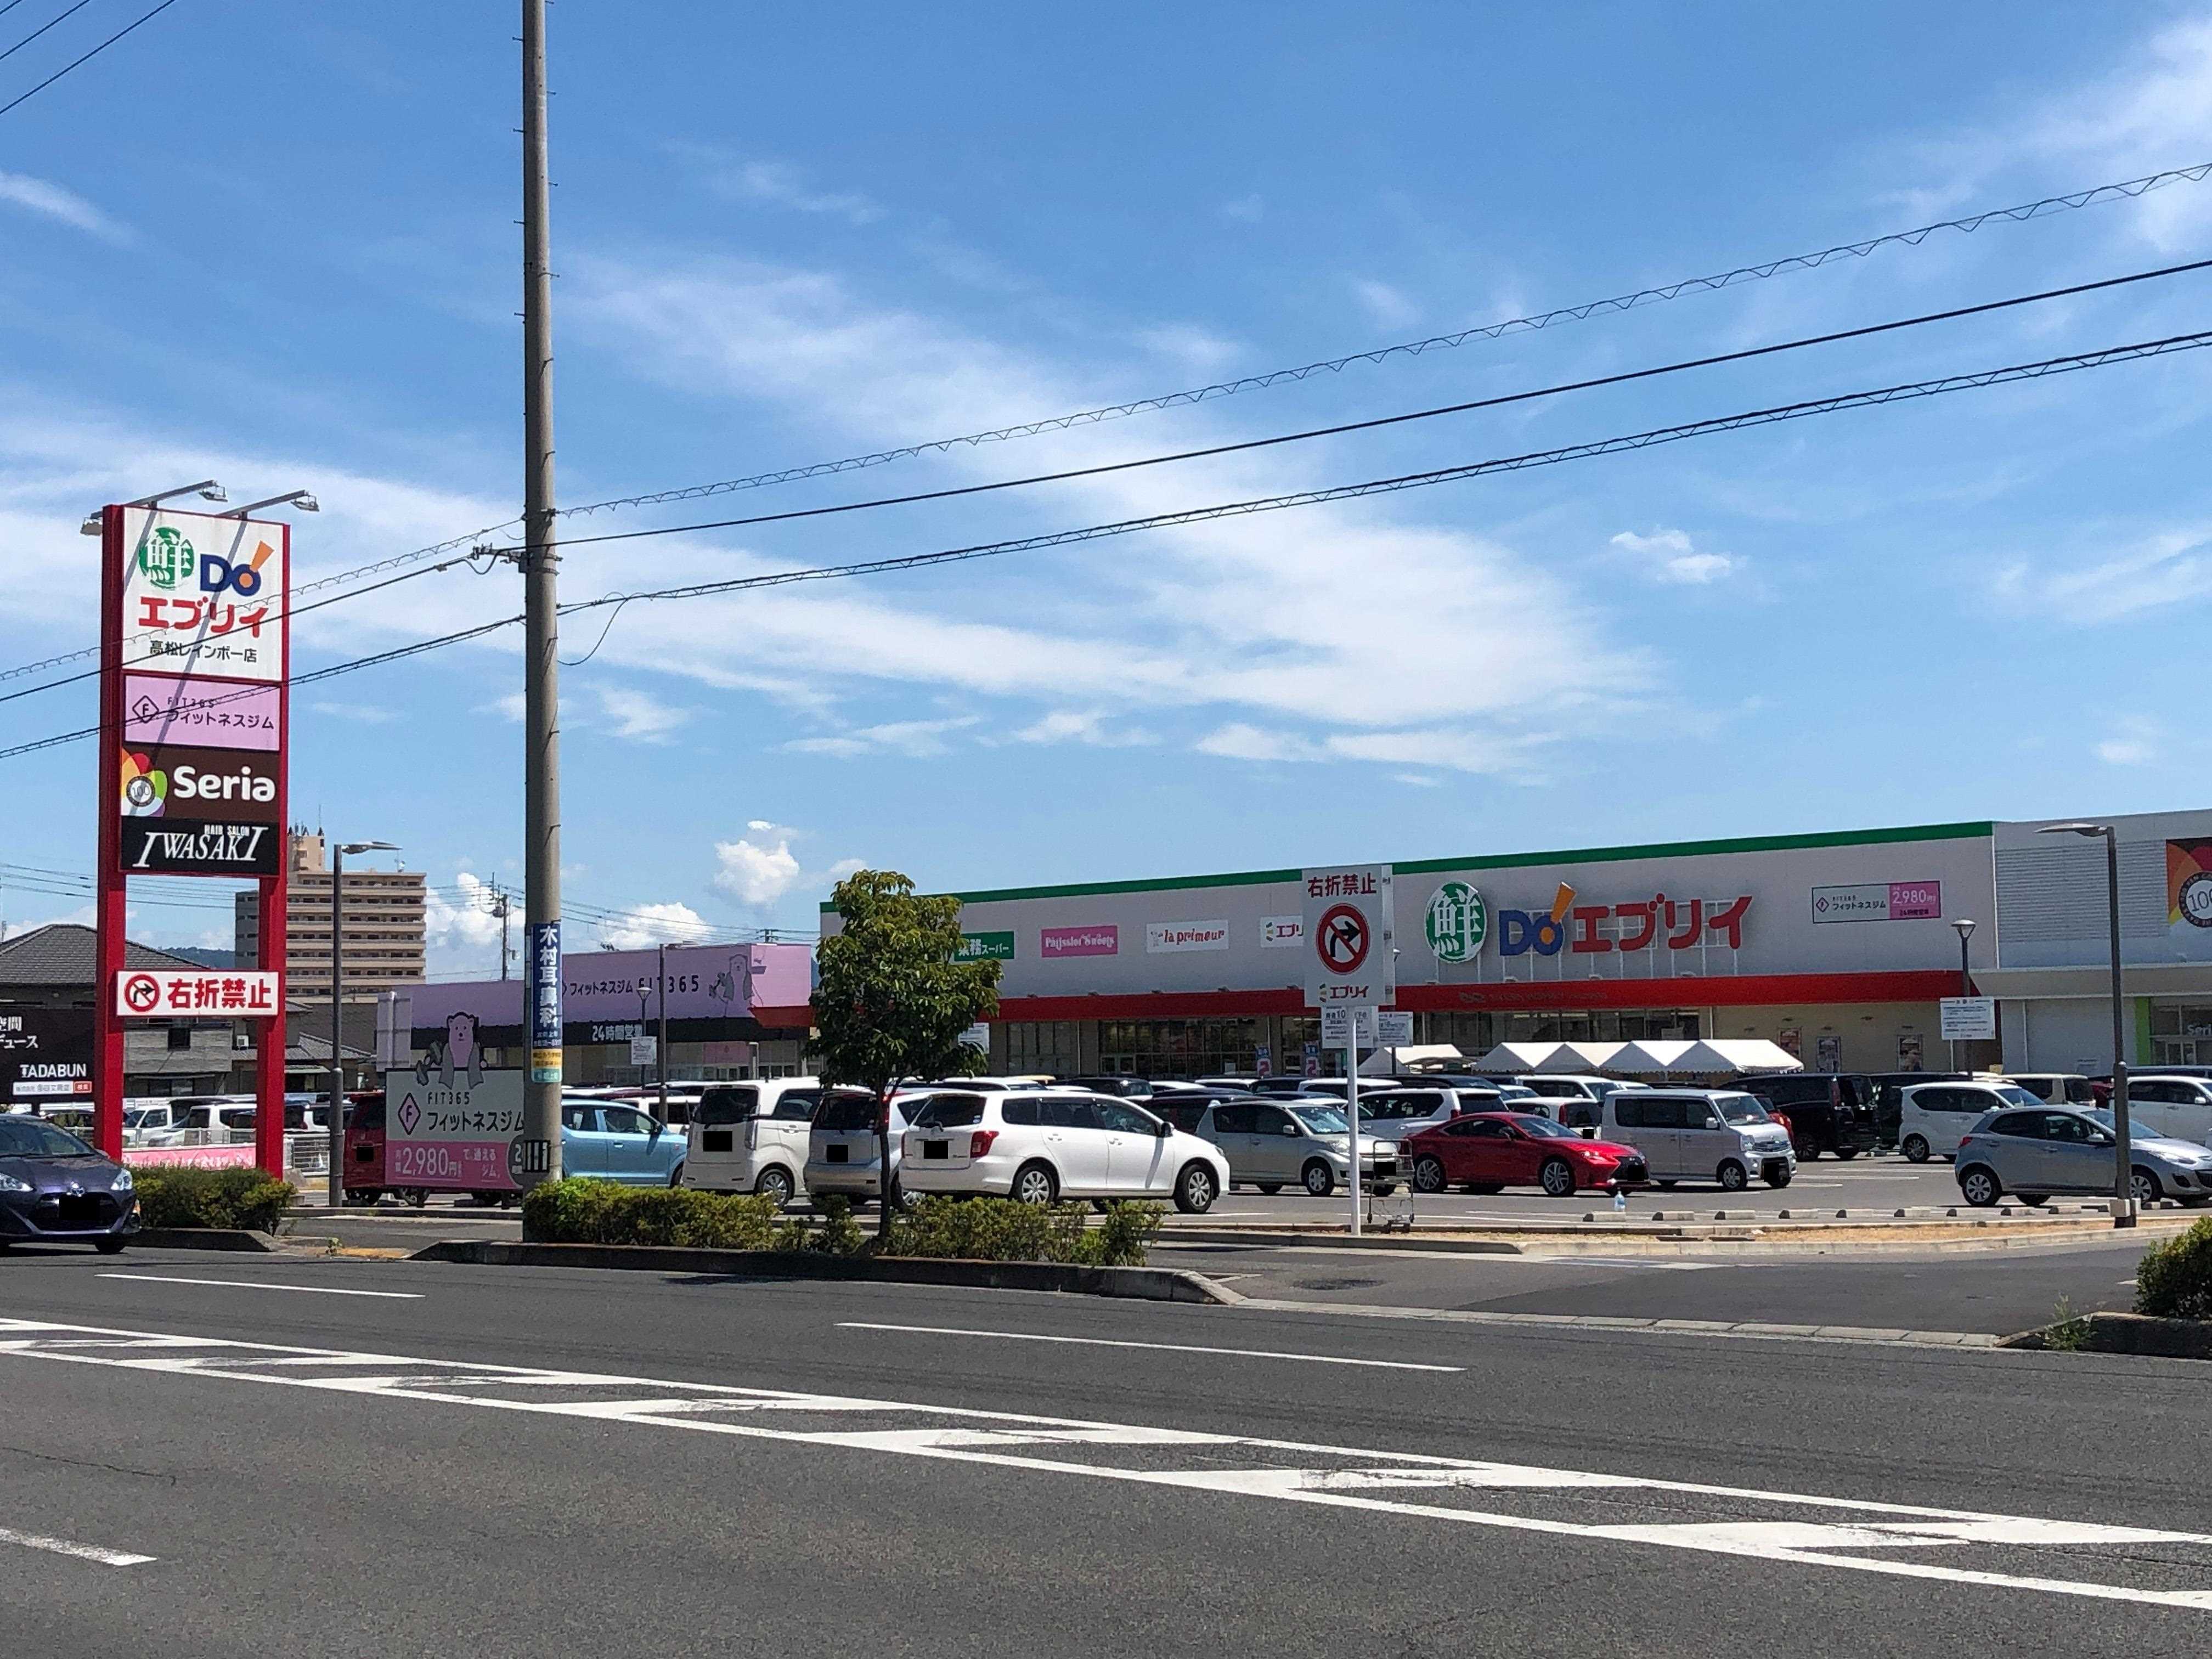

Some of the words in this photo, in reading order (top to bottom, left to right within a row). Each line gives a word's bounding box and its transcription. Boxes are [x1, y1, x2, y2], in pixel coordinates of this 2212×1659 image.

[149, 640, 257, 663] 高松レインボー店
[167, 709, 274, 729] フィットネスジム
[174, 765, 275, 802] Seria
[204, 825, 223, 835] HAIR
[227, 825, 250, 837] SALON
[132, 826, 269, 867] IWASAKI
[1307, 872, 1376, 898] 右折禁止
[1832, 900, 1886, 911] フィットネスジム
[539, 926, 558, 1028] 木村耳鼻科
[570, 979, 633, 996] フィットネスジム
[167, 978, 272, 1009] 右折禁止
[19, 1063, 87, 1078] TADABUN
[427, 1091, 471, 1105] FIT365
[427, 1111, 524, 1132] フィットネスジム
